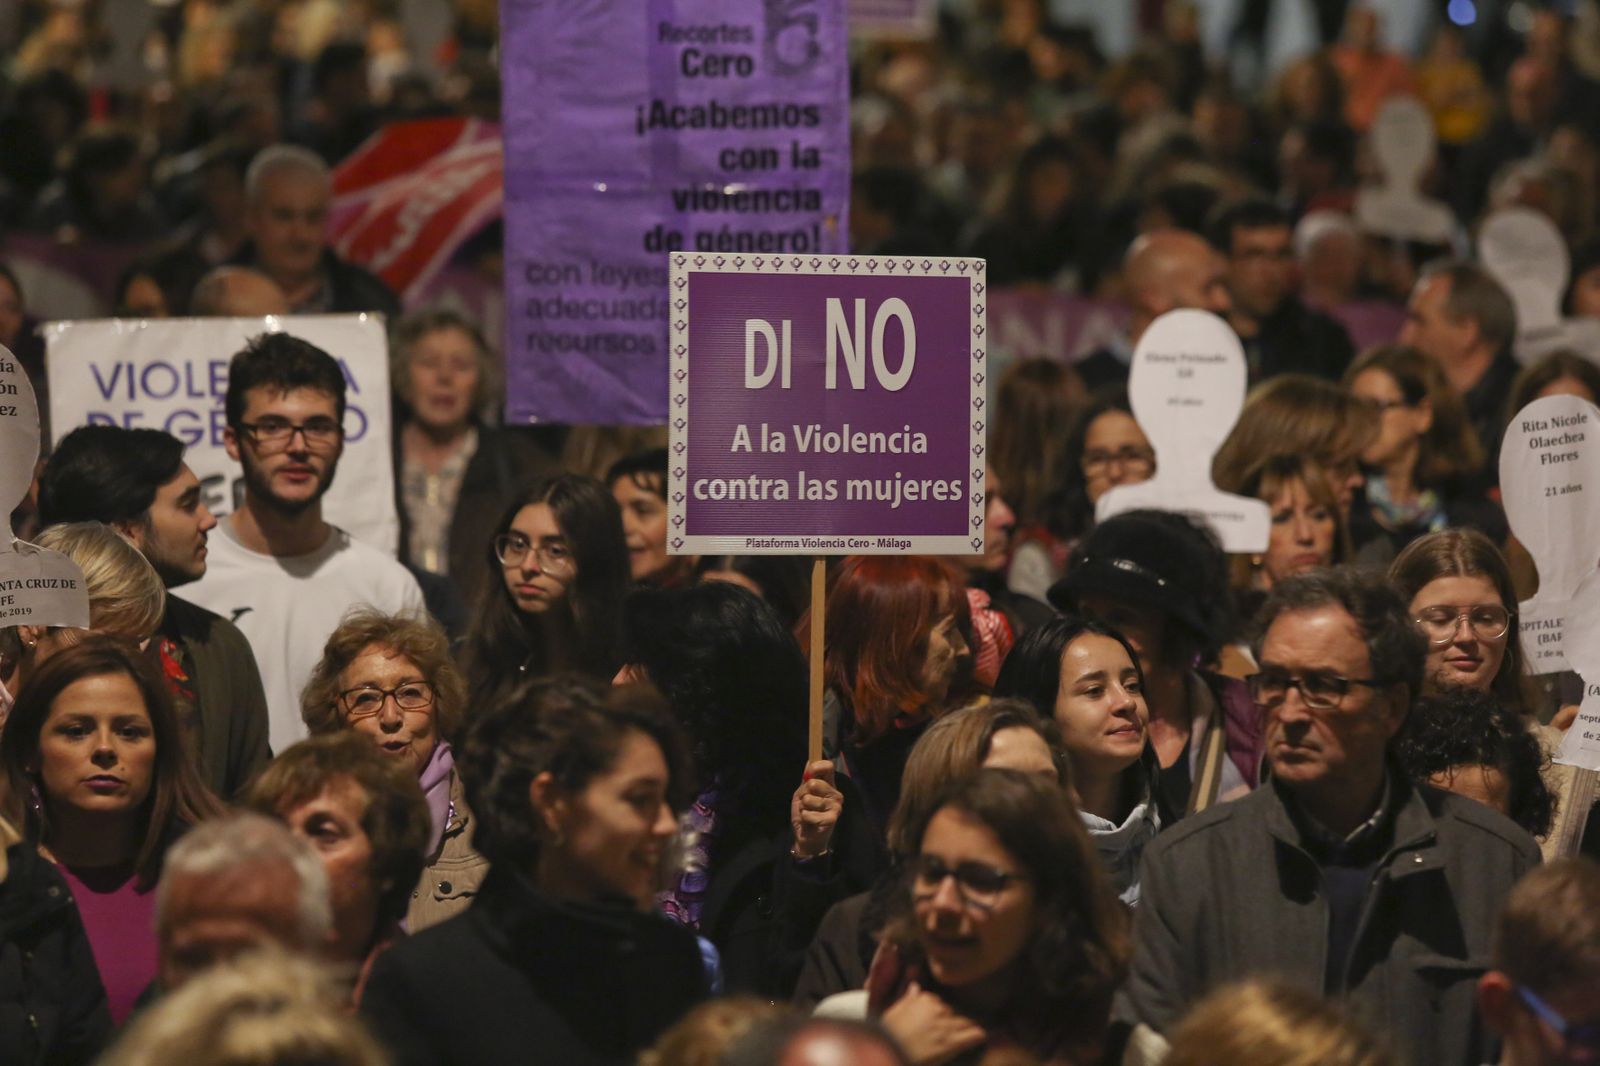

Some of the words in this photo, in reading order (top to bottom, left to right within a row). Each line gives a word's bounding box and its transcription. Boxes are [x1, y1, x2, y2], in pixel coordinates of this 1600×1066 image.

[658, 21, 753, 43] Recortes
[681, 48, 753, 77] Cero
[636, 99, 820, 135] ¡Acabemos
[719, 148, 778, 170] con
[791, 141, 820, 169] la
[671, 183, 821, 213] violencia
[644, 225, 683, 253] de
[526, 264, 581, 286] con
[527, 332, 656, 354] recursos
[745, 318, 791, 389] DI
[825, 297, 916, 391] NO
[1522, 420, 1548, 433] Rita
[1551, 413, 1588, 429] Nicole
[731, 424, 752, 453] A
[761, 423, 786, 453] la
[793, 424, 927, 454] Violencia
[1529, 432, 1585, 449] Olaechea
[1541, 451, 1579, 465] Flores
[693, 474, 789, 501] contra
[798, 471, 838, 501] las
[846, 471, 962, 509] mujeres
[1545, 487, 1557, 497] 21
[1560, 484, 1582, 495] años
[745, 538, 800, 549] Plataforma
[801, 538, 846, 549] Violencia
[847, 538, 870, 549] Cero
[877, 538, 912, 550] Málaga
[26, 579, 58, 589] CRUZ
[61, 579, 76, 589] DE
[1, 595, 15, 606] FE
[9, 607, 33, 617] 2019
[1583, 731, 1594, 740] de
